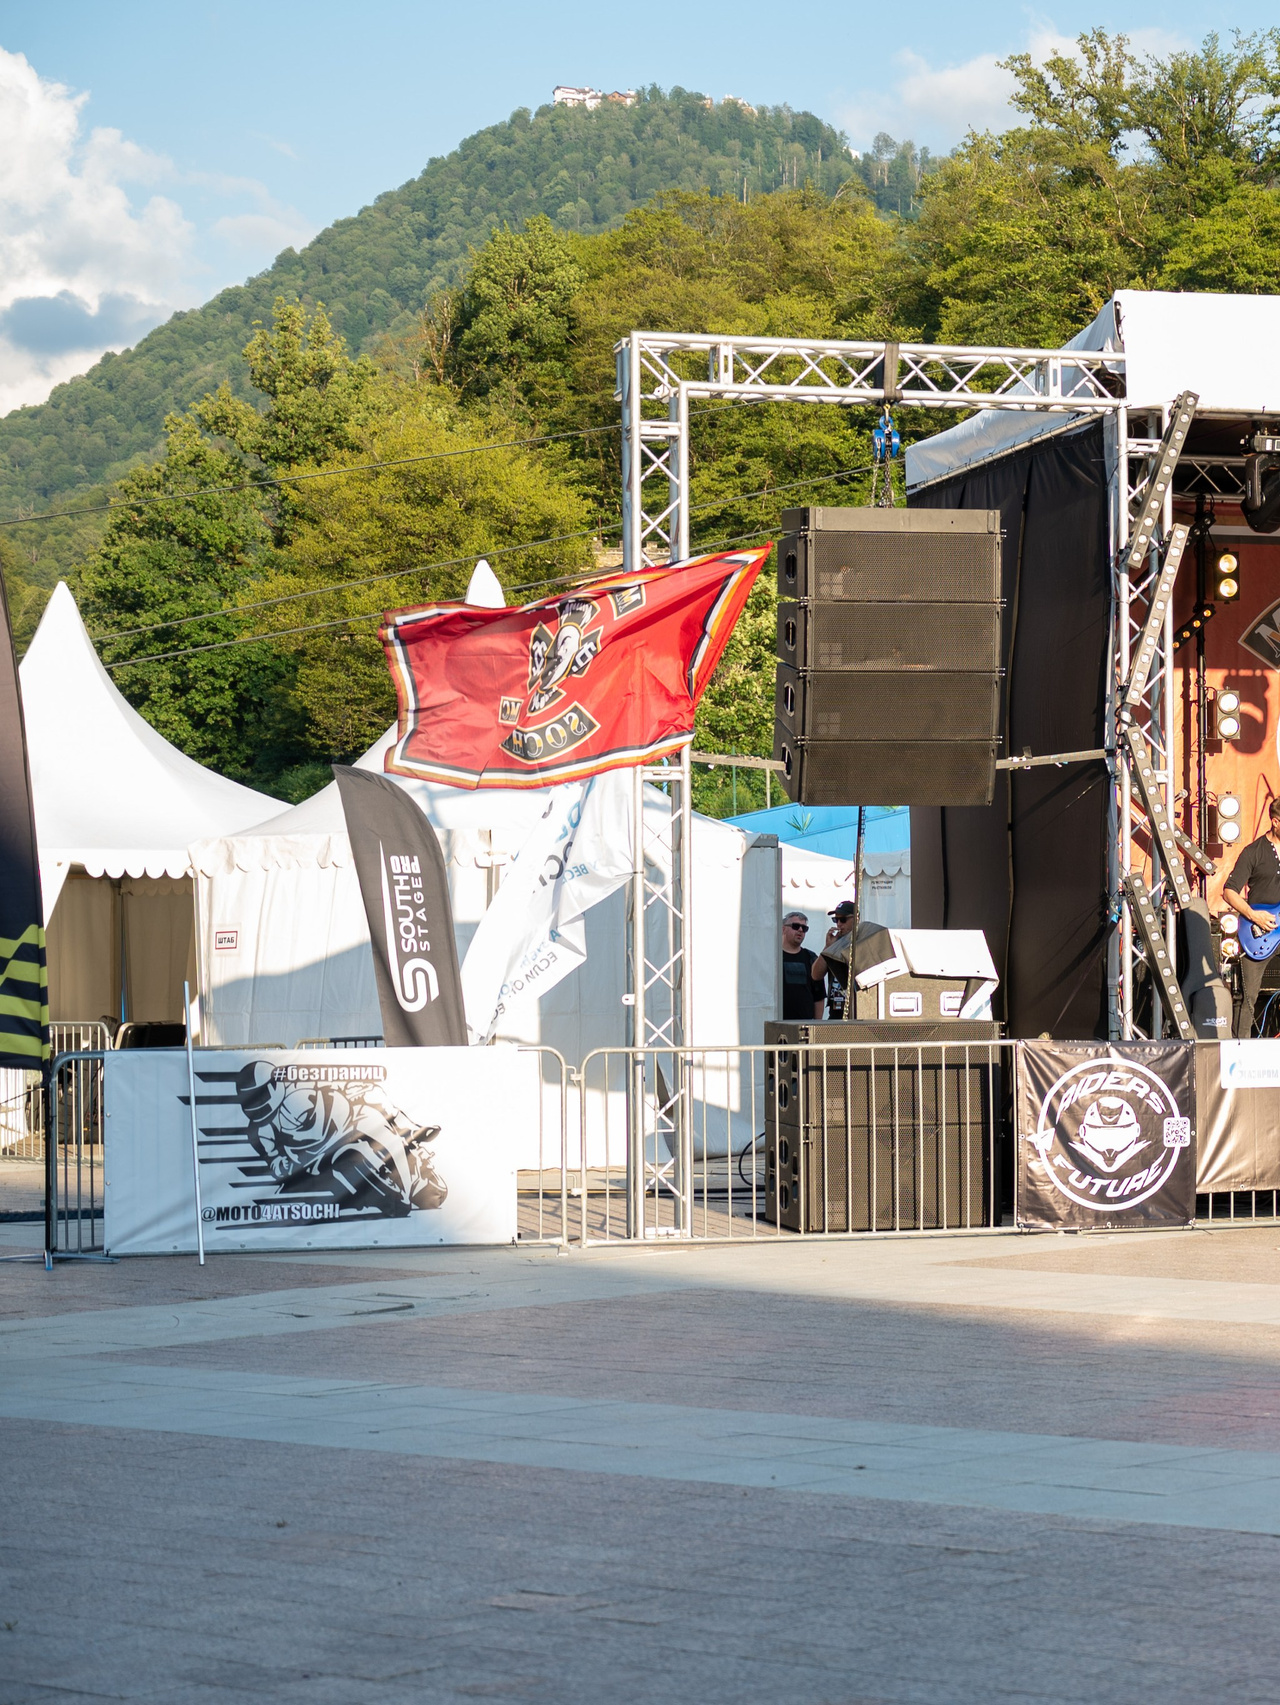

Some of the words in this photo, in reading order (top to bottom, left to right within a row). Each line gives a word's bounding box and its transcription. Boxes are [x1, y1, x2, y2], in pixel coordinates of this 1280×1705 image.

[390, 855, 421, 874] PRO
[393, 875, 417, 953] SOUTH
[411, 876, 431, 951] STAGE
[217, 936, 235, 944] ШТАБ
[273, 1065, 385, 1082] #безграниц
[1055, 1071, 1167, 1125] RIDERS
[1053, 1148, 1168, 1198] FUTURE
